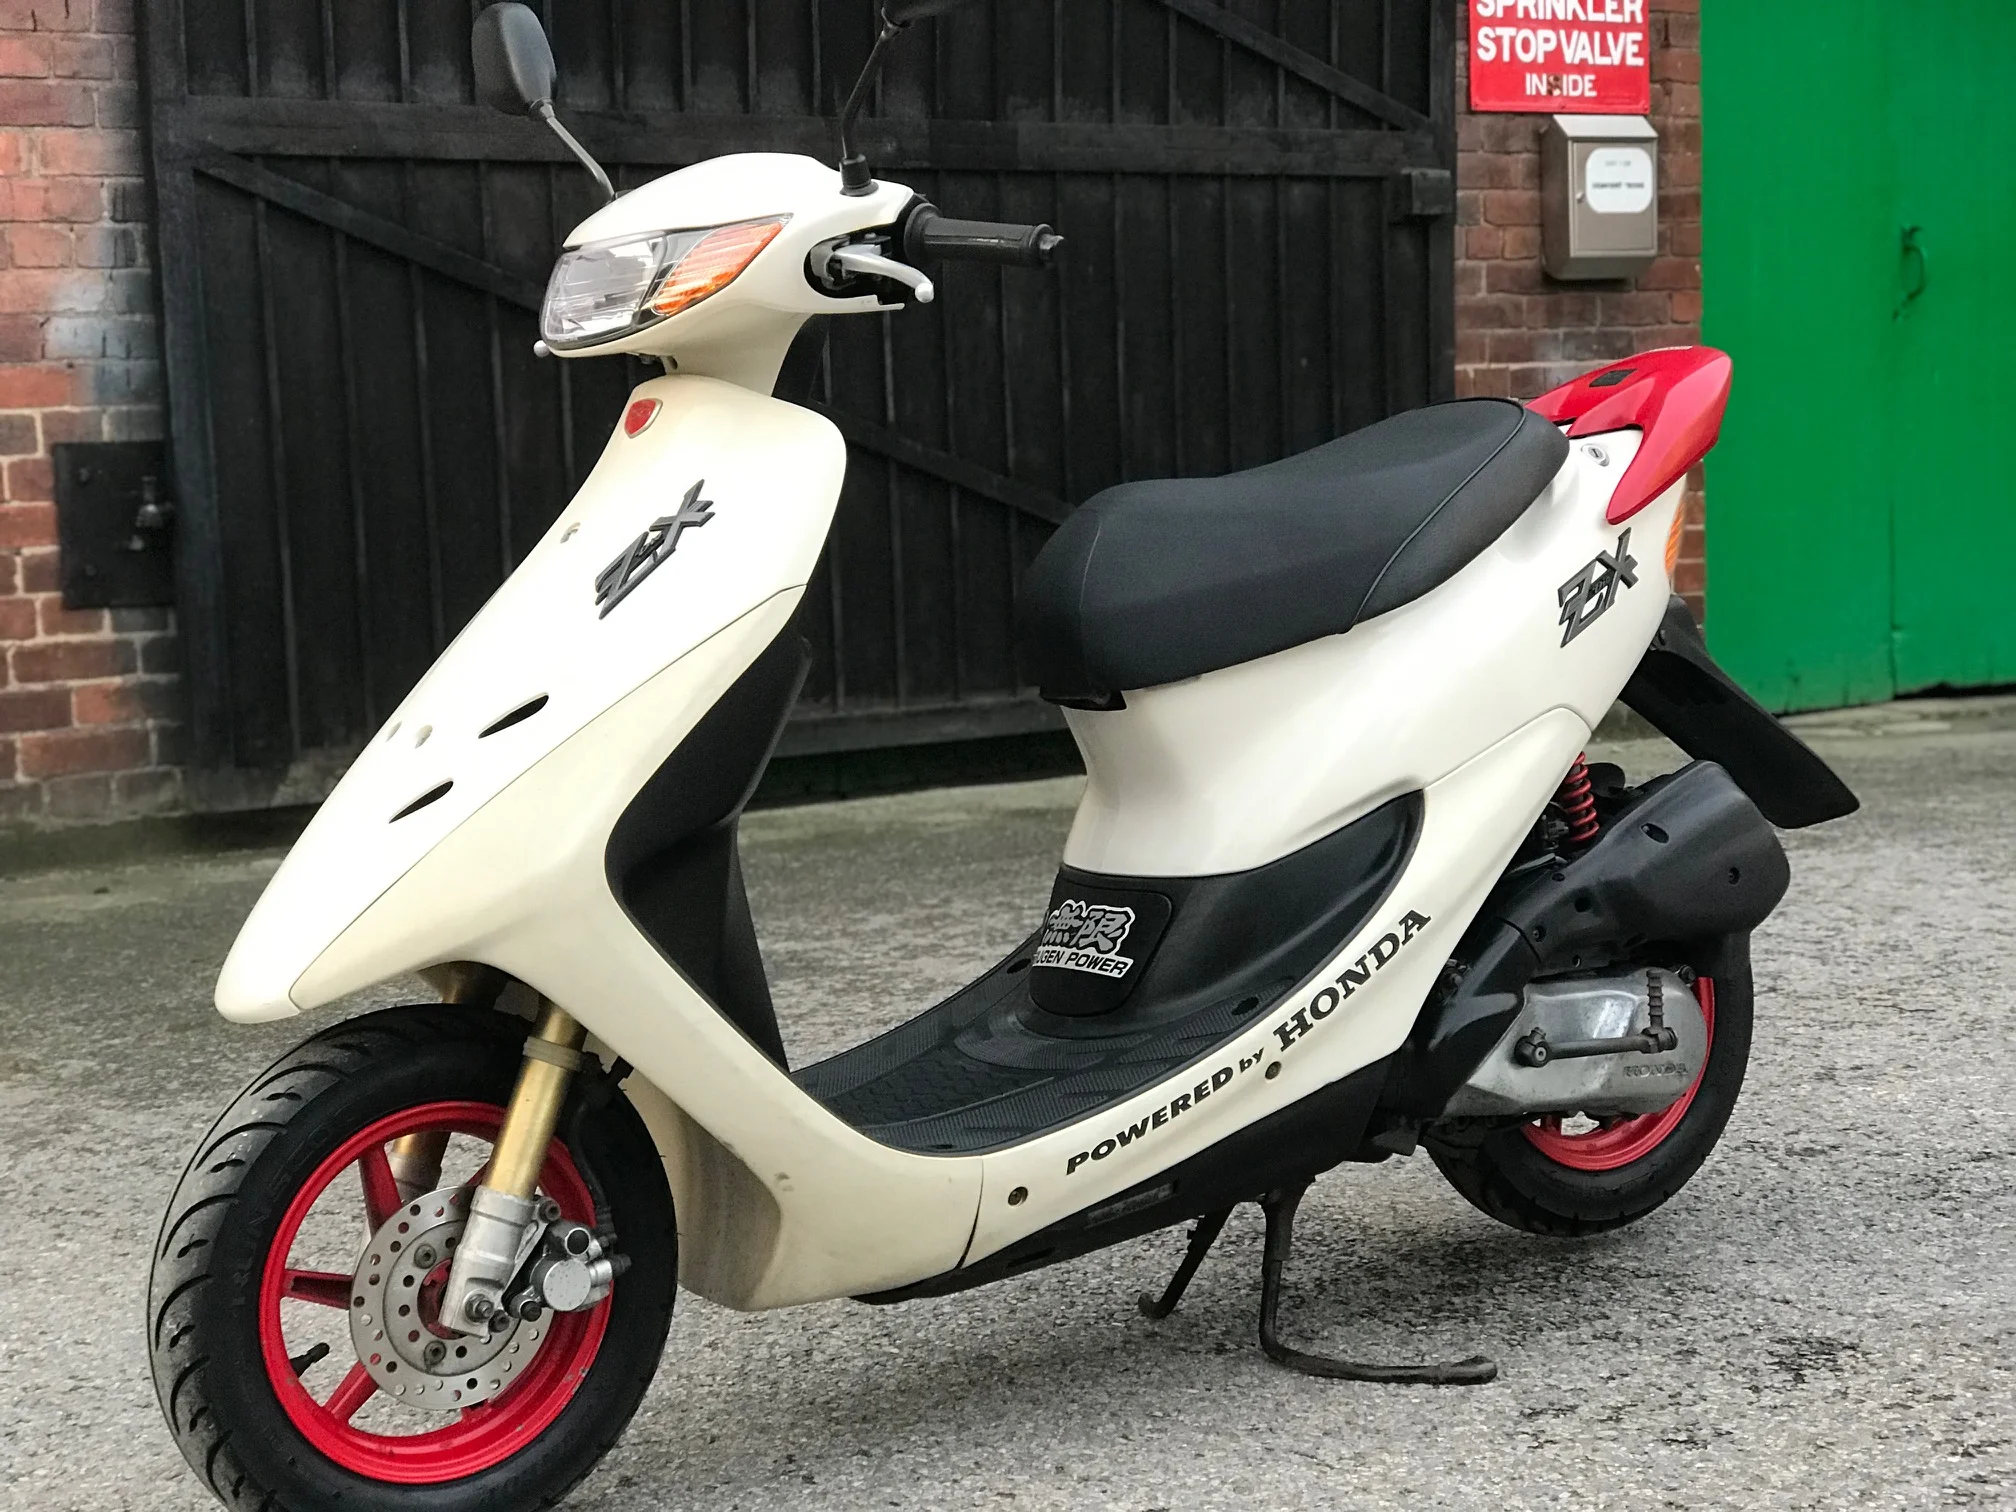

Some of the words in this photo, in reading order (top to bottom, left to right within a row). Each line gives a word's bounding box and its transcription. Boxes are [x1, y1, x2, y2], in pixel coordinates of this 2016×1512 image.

[1476, 0, 1643, 24] SPRINKLER
[1476, 26, 1557, 64] STOP
[1559, 29, 1645, 66] VALVE
[1525, 72, 1598, 97] INSIDE
[1065, 951, 1129, 975] POWER
[1066, 1066, 1234, 1176] POWERED
[1239, 1047, 1265, 1074] by
[1273, 908, 1432, 1052] HONDA
[1622, 1062, 1689, 1078] HONDA
